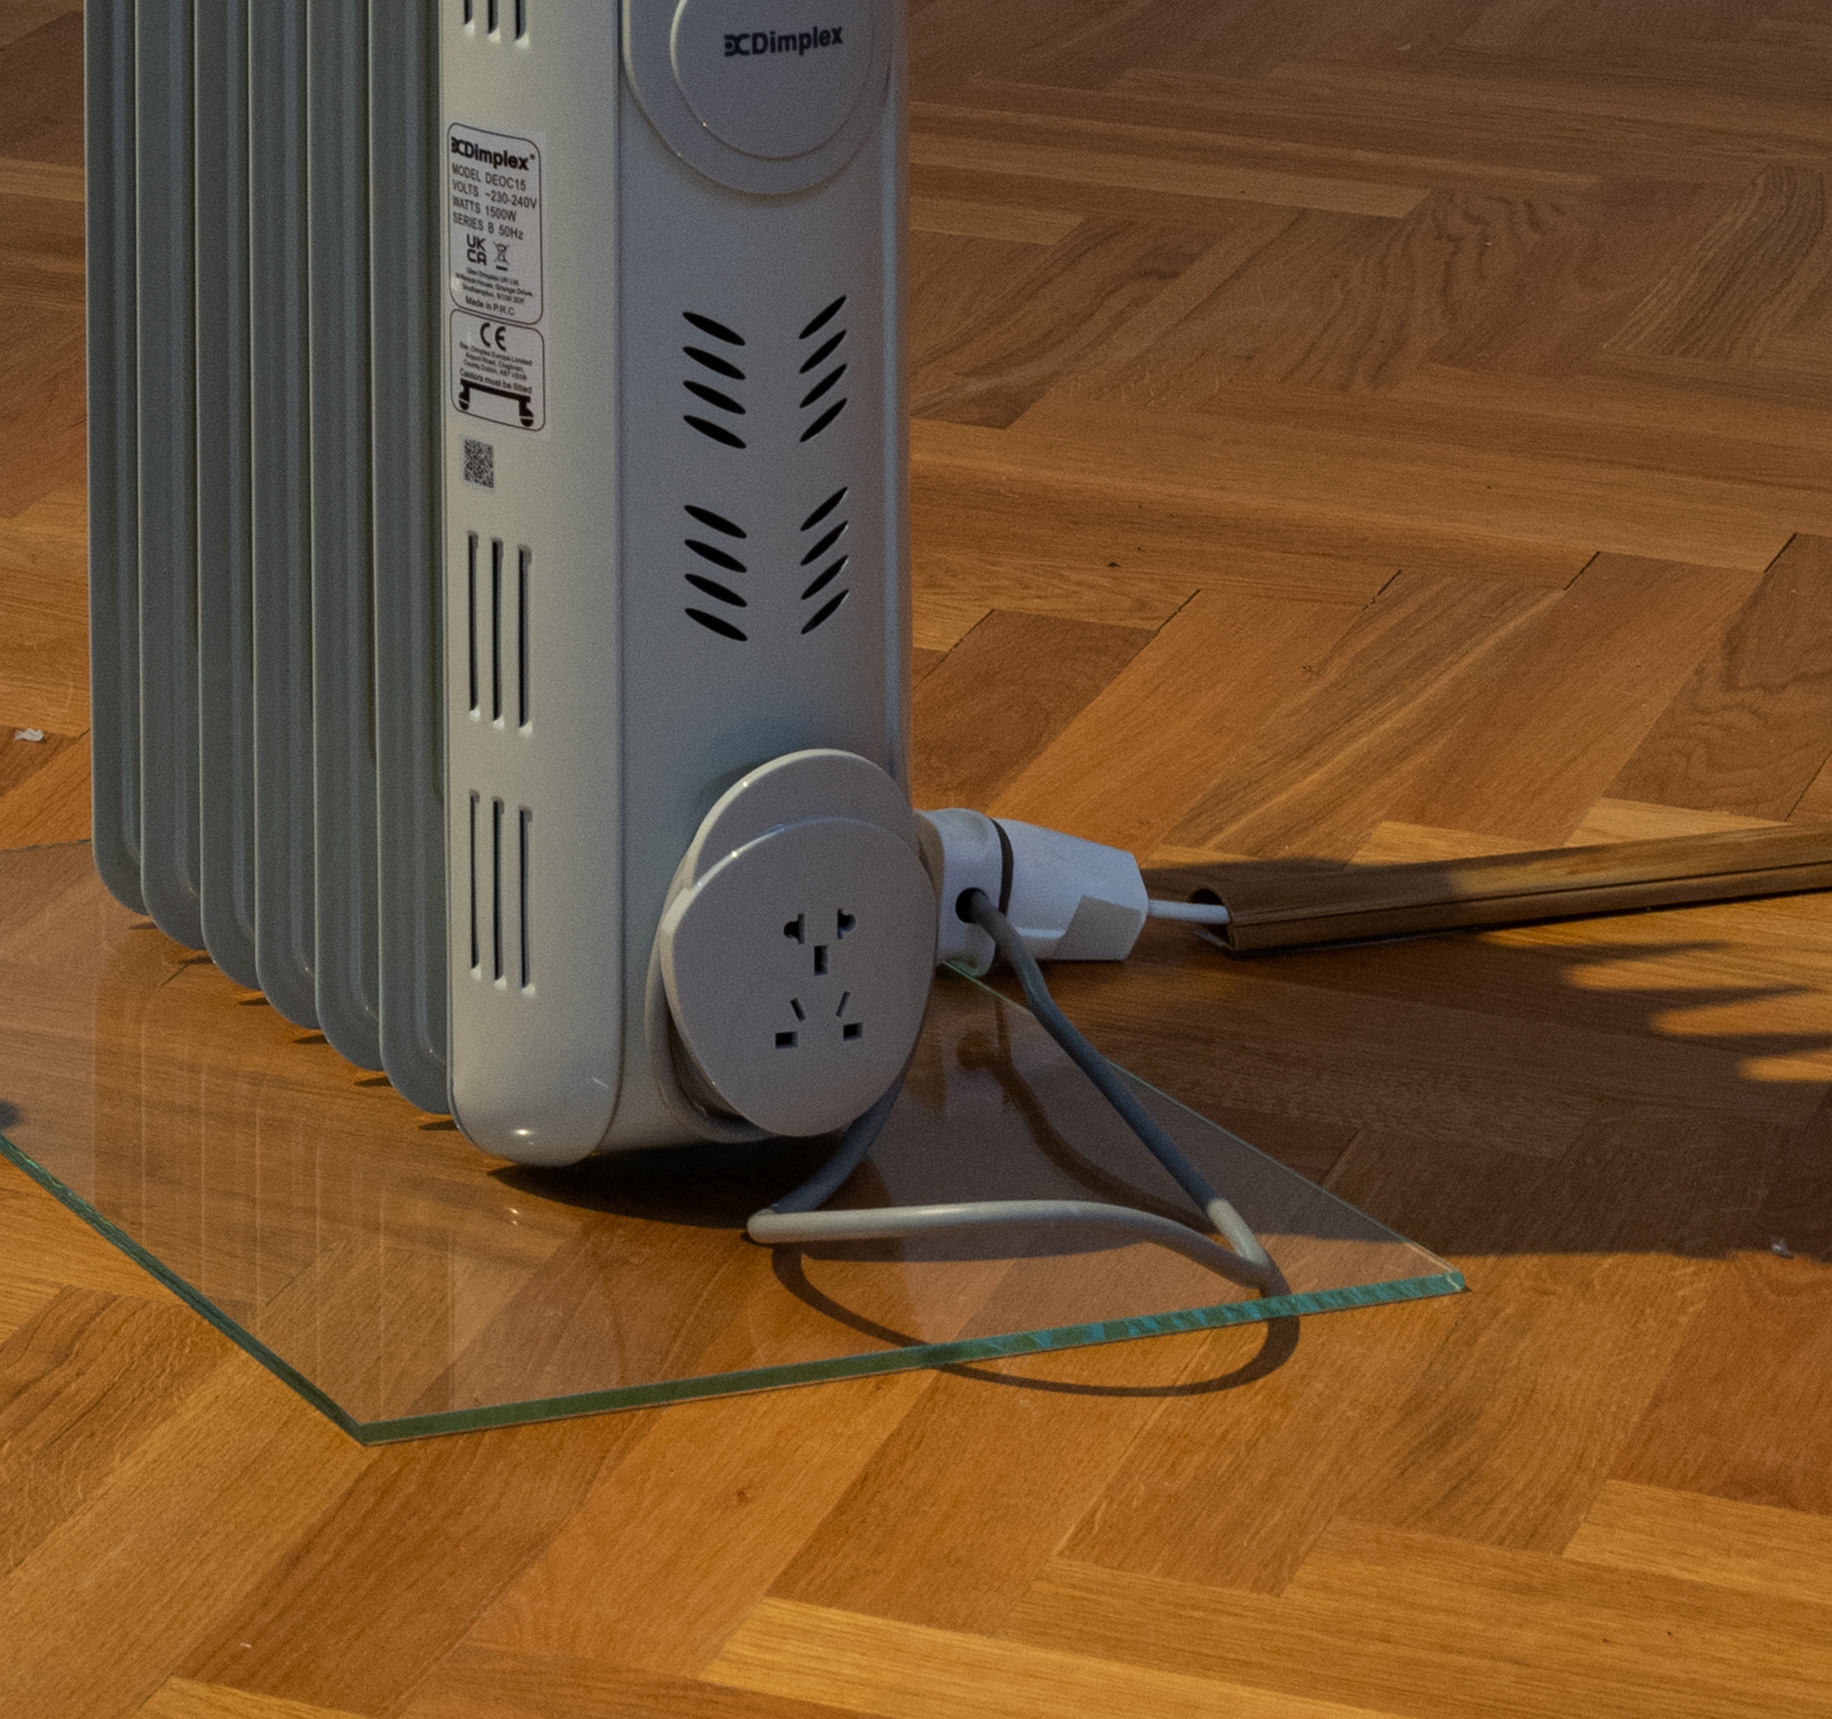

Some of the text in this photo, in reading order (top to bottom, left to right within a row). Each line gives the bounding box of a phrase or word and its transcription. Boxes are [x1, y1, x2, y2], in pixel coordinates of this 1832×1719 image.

[452, 162, 526, 191] MODEL DEOC15
[452, 178, 479, 197] VOLTS
[452, 196, 517, 222] WATTS 1500W
[452, 211, 484, 231] SERIES
[499, 224, 524, 240] 50Hz
[466, 233, 486, 252] UK
[465, 295, 484, 308] Made
[485, 301, 492, 310] in
